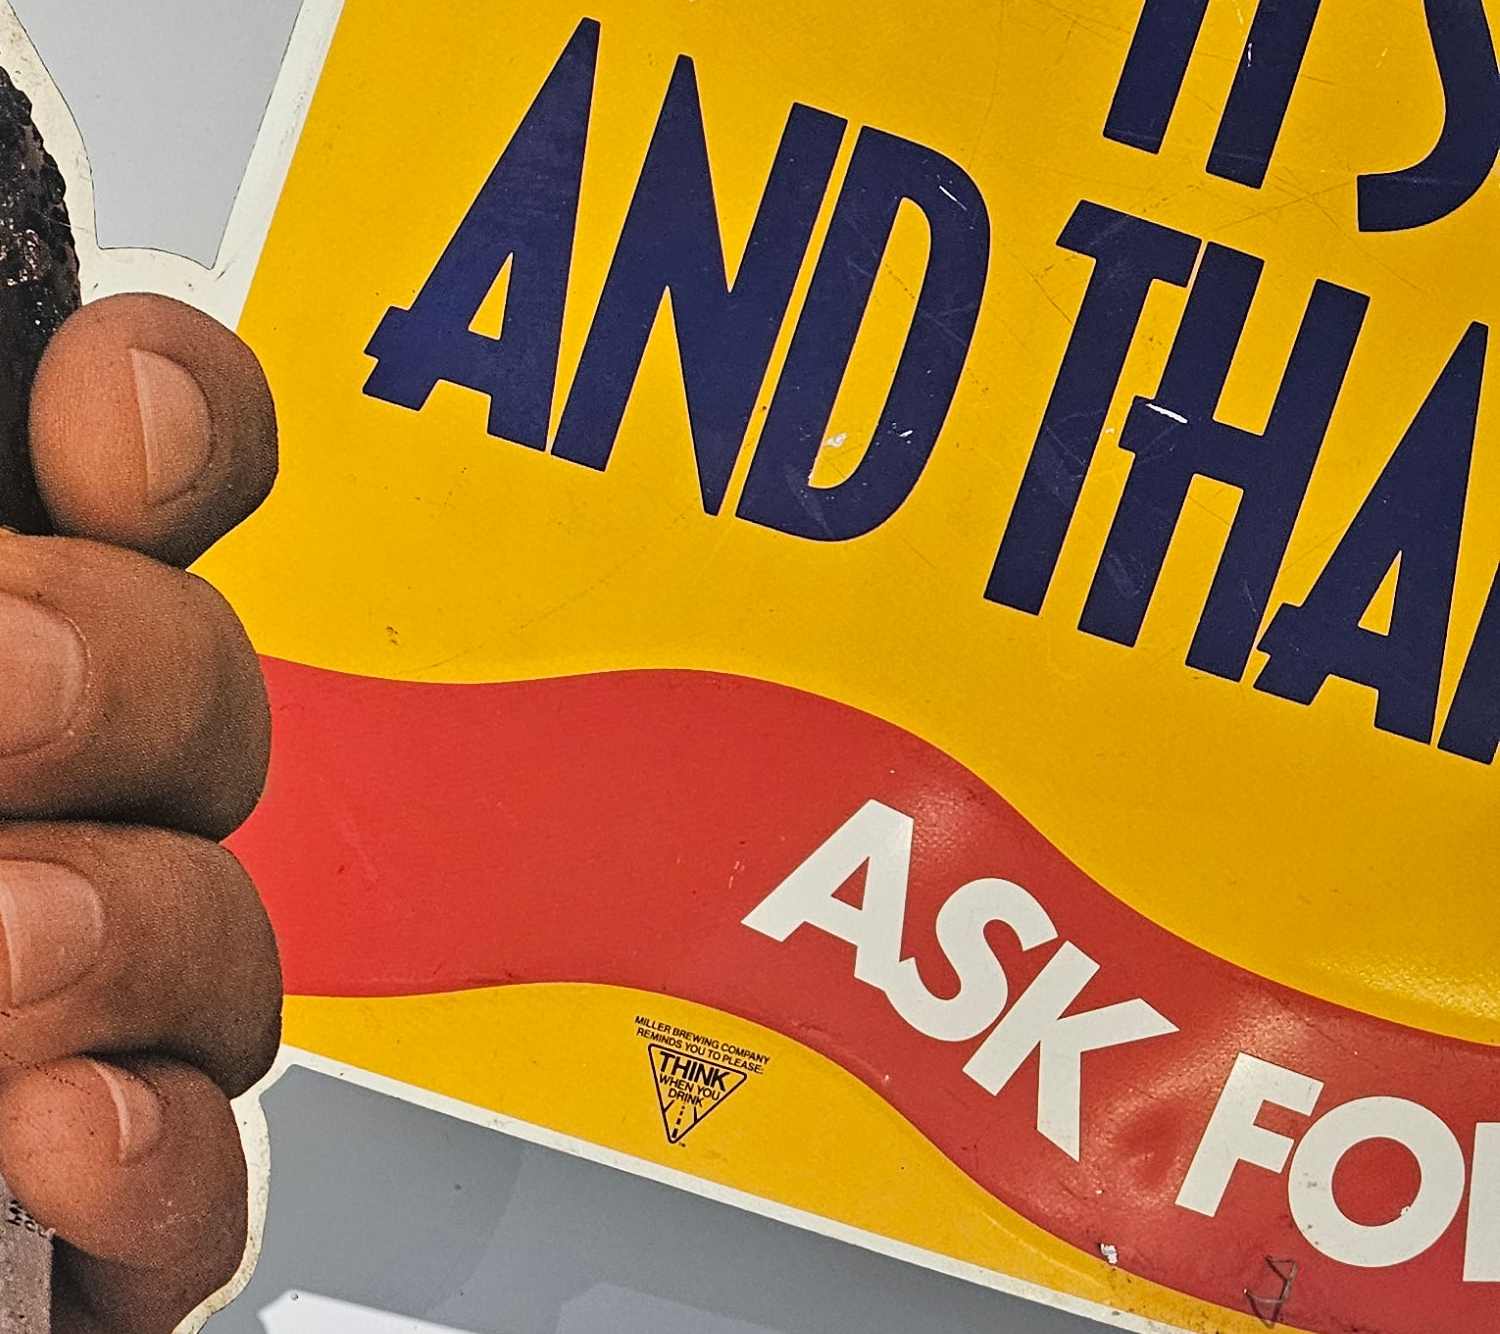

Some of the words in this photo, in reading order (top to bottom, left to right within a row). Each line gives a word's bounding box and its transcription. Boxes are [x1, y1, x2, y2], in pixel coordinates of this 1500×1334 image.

[362, 17, 991, 542] AND
[741, 799, 1180, 1162] ASK
[635, 1016, 672, 1035] MILLER
[672, 1027, 720, 1050] BREWING
[720, 1043, 771, 1065] COMPANY
[636, 1027, 683, 1049] REMINDS
[685, 1041, 706, 1056] YOU
[707, 1049, 721, 1060] TO
[659, 1051, 731, 1092] THINK
[659, 1073, 695, 1093] WHEN
[697, 1085, 721, 1102] YOU
[668, 1087, 705, 1107] DRINK
